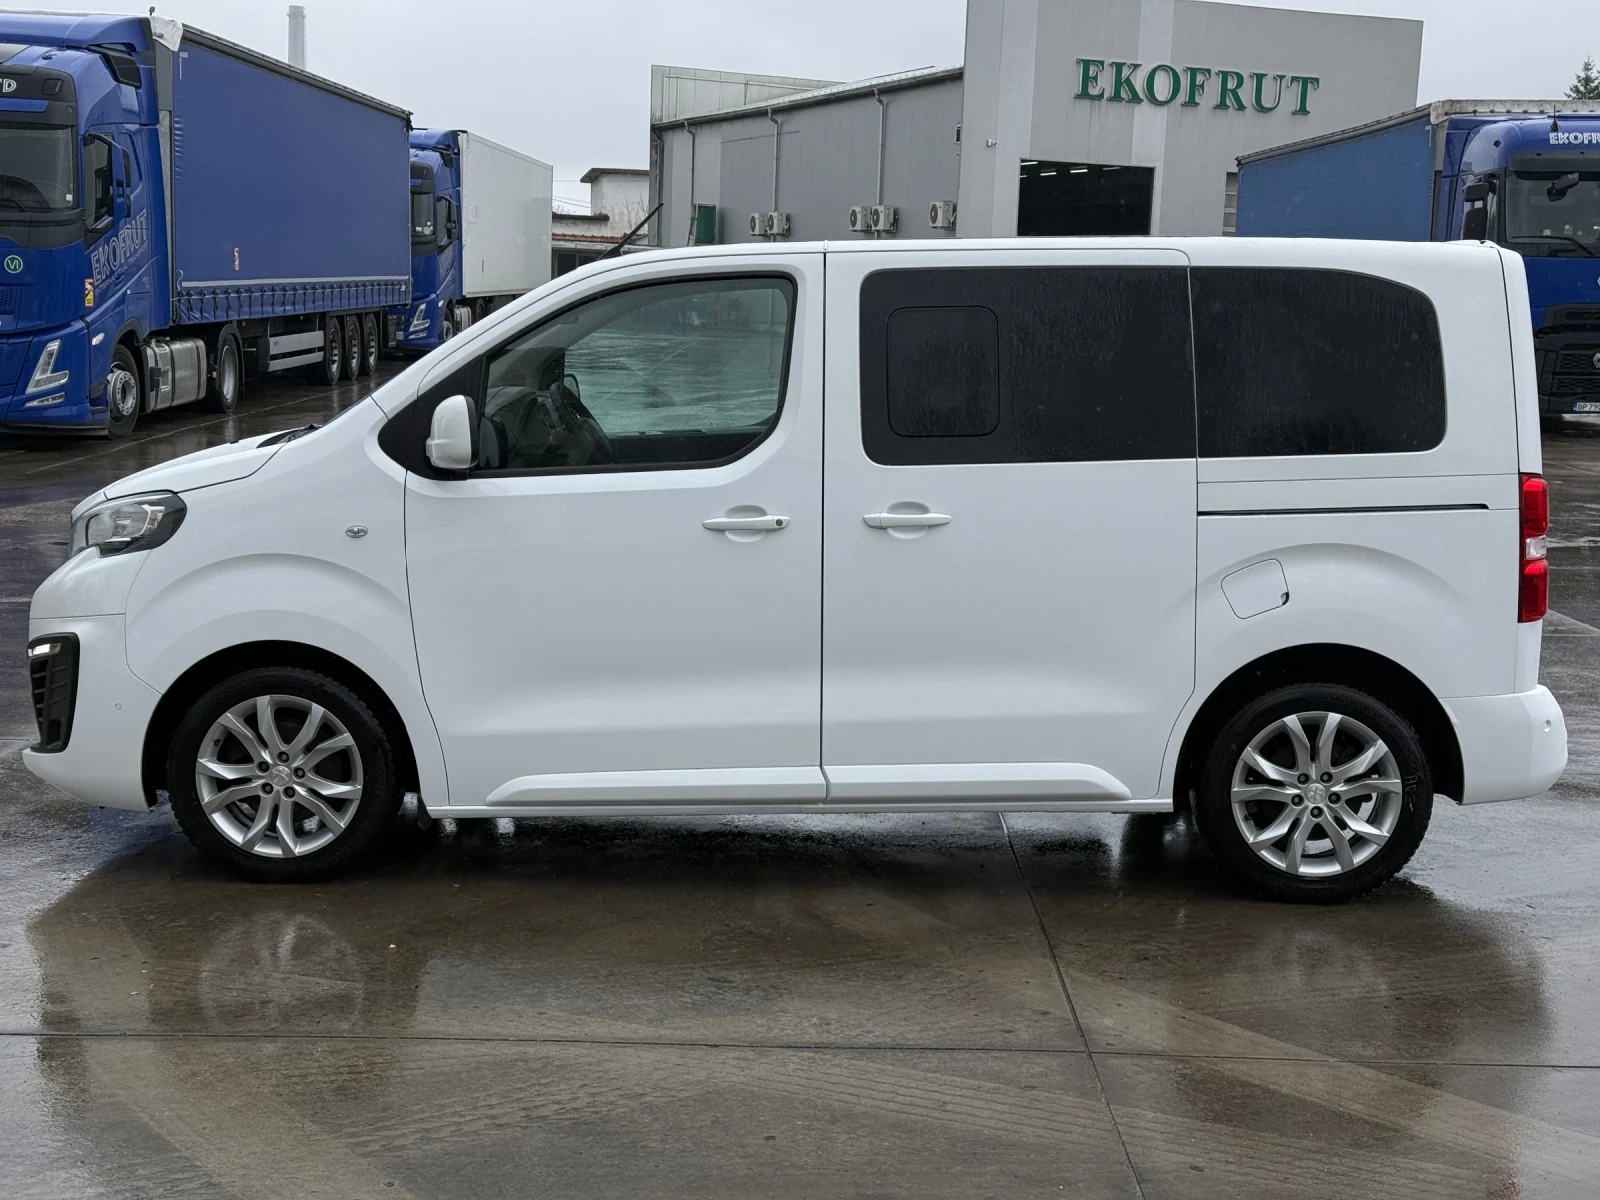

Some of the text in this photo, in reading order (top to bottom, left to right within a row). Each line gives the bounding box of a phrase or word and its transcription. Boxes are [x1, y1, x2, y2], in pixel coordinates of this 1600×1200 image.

[0, 78, 17, 93] D
[1074, 57, 1320, 115] EKOFRUT
[7, 259, 19, 270] VI
[91, 208, 147, 286] EKOFRUT
